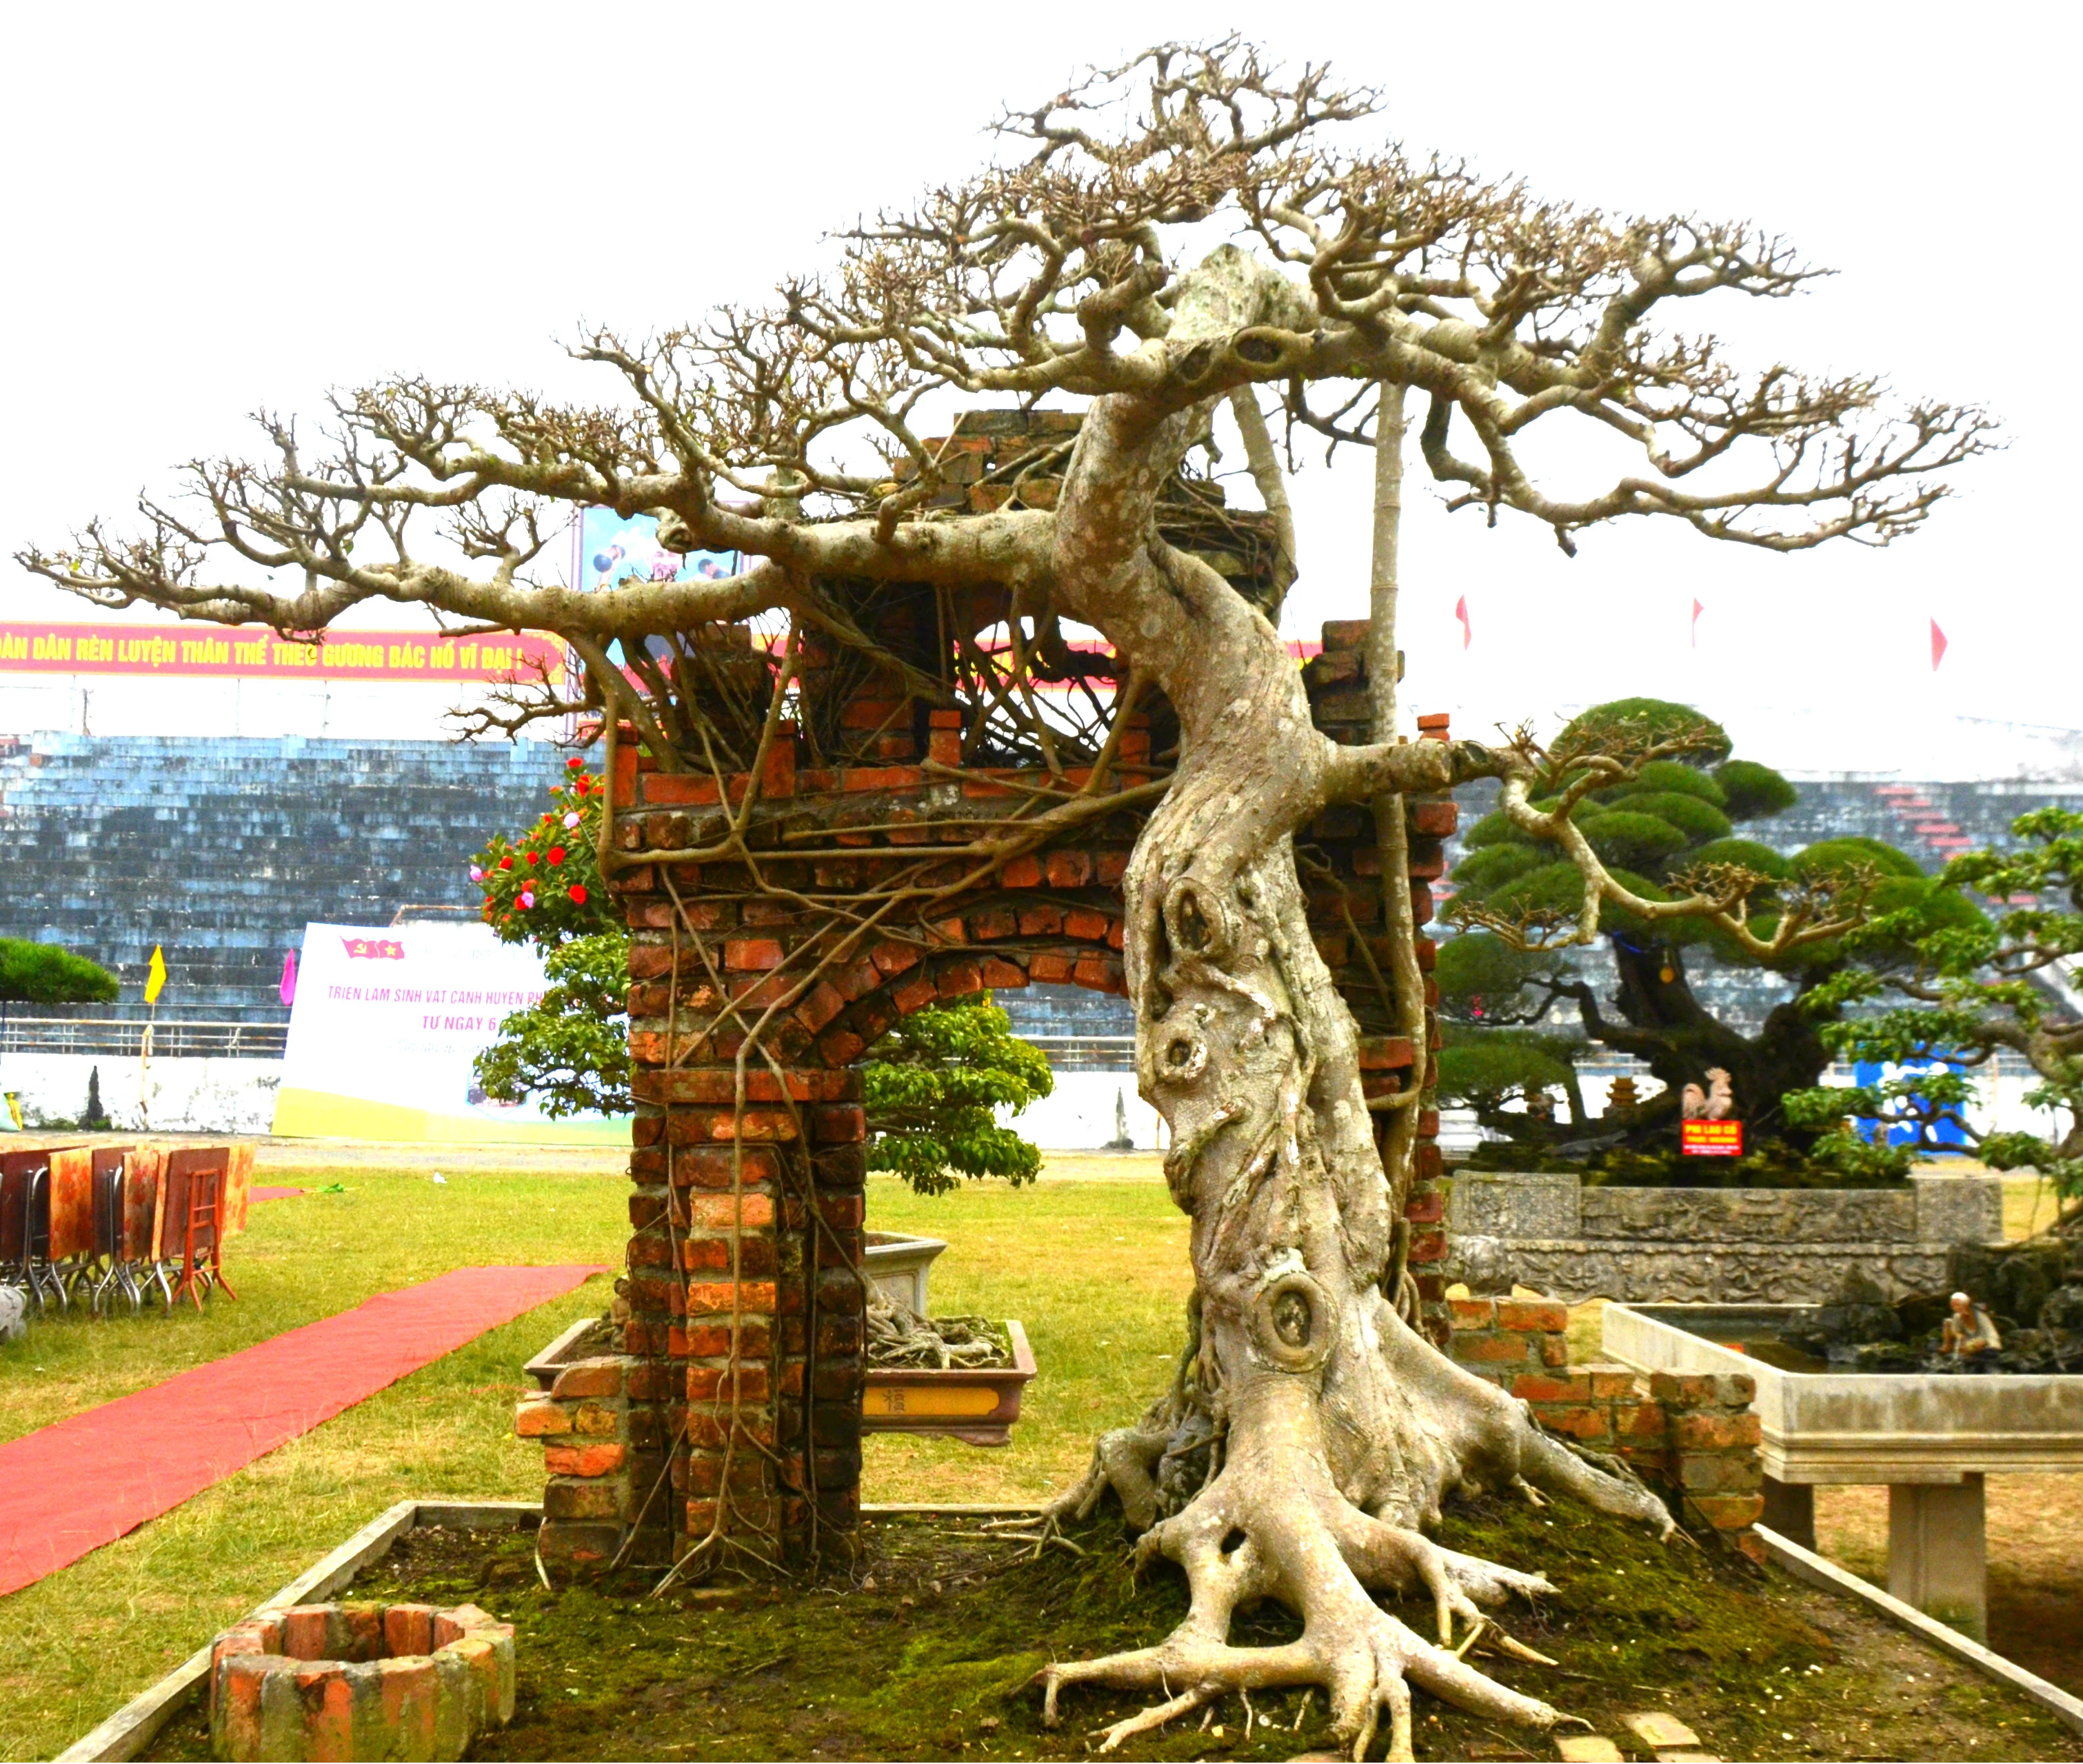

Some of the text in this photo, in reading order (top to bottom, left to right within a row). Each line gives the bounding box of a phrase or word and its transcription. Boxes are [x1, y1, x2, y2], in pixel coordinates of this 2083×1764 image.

[0, 632, 28, 660] ÀN
[32, 633, 72, 660] DÂN
[76, 634, 114, 661] RÈN
[118, 636, 177, 667] LUYỆN
[181, 637, 230, 664] THÂN
[234, 634, 267, 665] THỂ
[272, 643, 318, 667] THEO
[322, 643, 385, 668] GƯƠNG
[388, 641, 426, 669] BÁC
[459, 643, 479, 670] VĨ
[481, 647, 512, 674] ĐẠI
[394, 989, 422, 1003] SINH
[488, 1017, 496, 1031] 6
